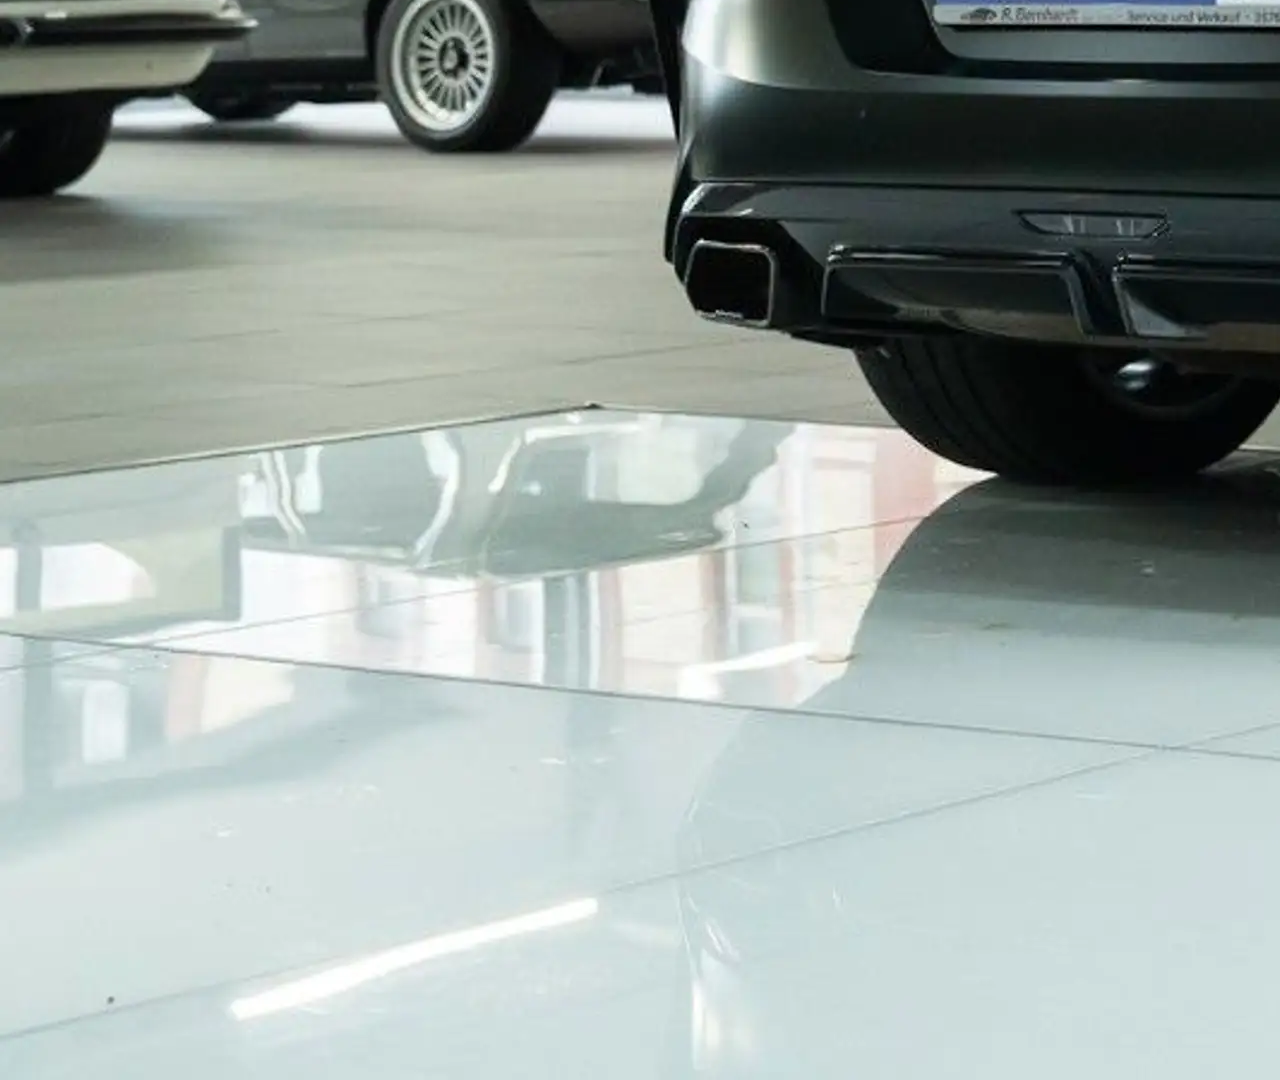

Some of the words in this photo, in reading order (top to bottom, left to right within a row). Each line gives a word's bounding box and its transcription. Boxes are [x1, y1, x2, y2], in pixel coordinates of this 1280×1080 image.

[1016, 6, 1079, 22] Bernhardt
[1127, 9, 1169, 24] Service
[1172, 9, 1194, 24] und
[1195, 10, 1241, 24] Verkauf
